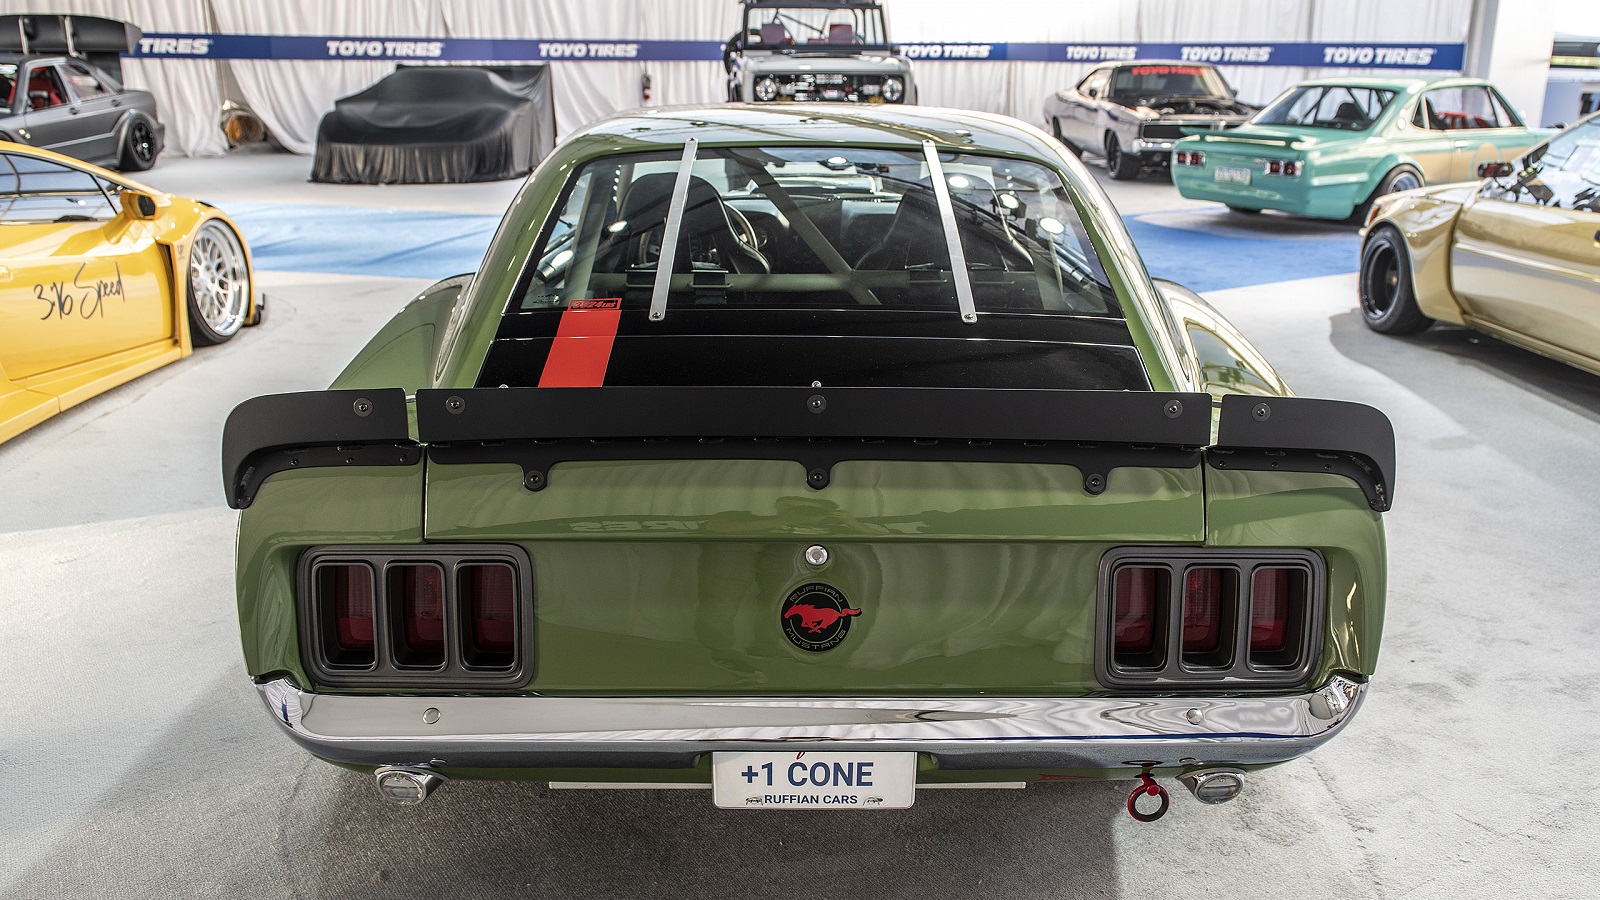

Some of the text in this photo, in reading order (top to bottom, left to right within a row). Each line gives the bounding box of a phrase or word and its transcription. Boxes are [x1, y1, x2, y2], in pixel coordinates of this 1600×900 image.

[139, 37, 209, 55] TIRES
[326, 41, 442, 57] TOYO TIRES
[538, 43, 638, 57] TOYO TIRES
[900, 44, 991, 59] TOYO TIRES
[1065, 45, 1137, 61] TOYO TIRES
[1180, 46, 1271, 62] TOYO TIRES
[1322, 47, 1434, 65] TOYO TIRES
[73, 261, 126, 320] Speed
[789, 585, 844, 603] RUFFIAN
[786, 627, 847, 650] MUSTANG
[741, 761, 874, 787] +1 CONE
[764, 794, 858, 804] RUFFIAN CARS
